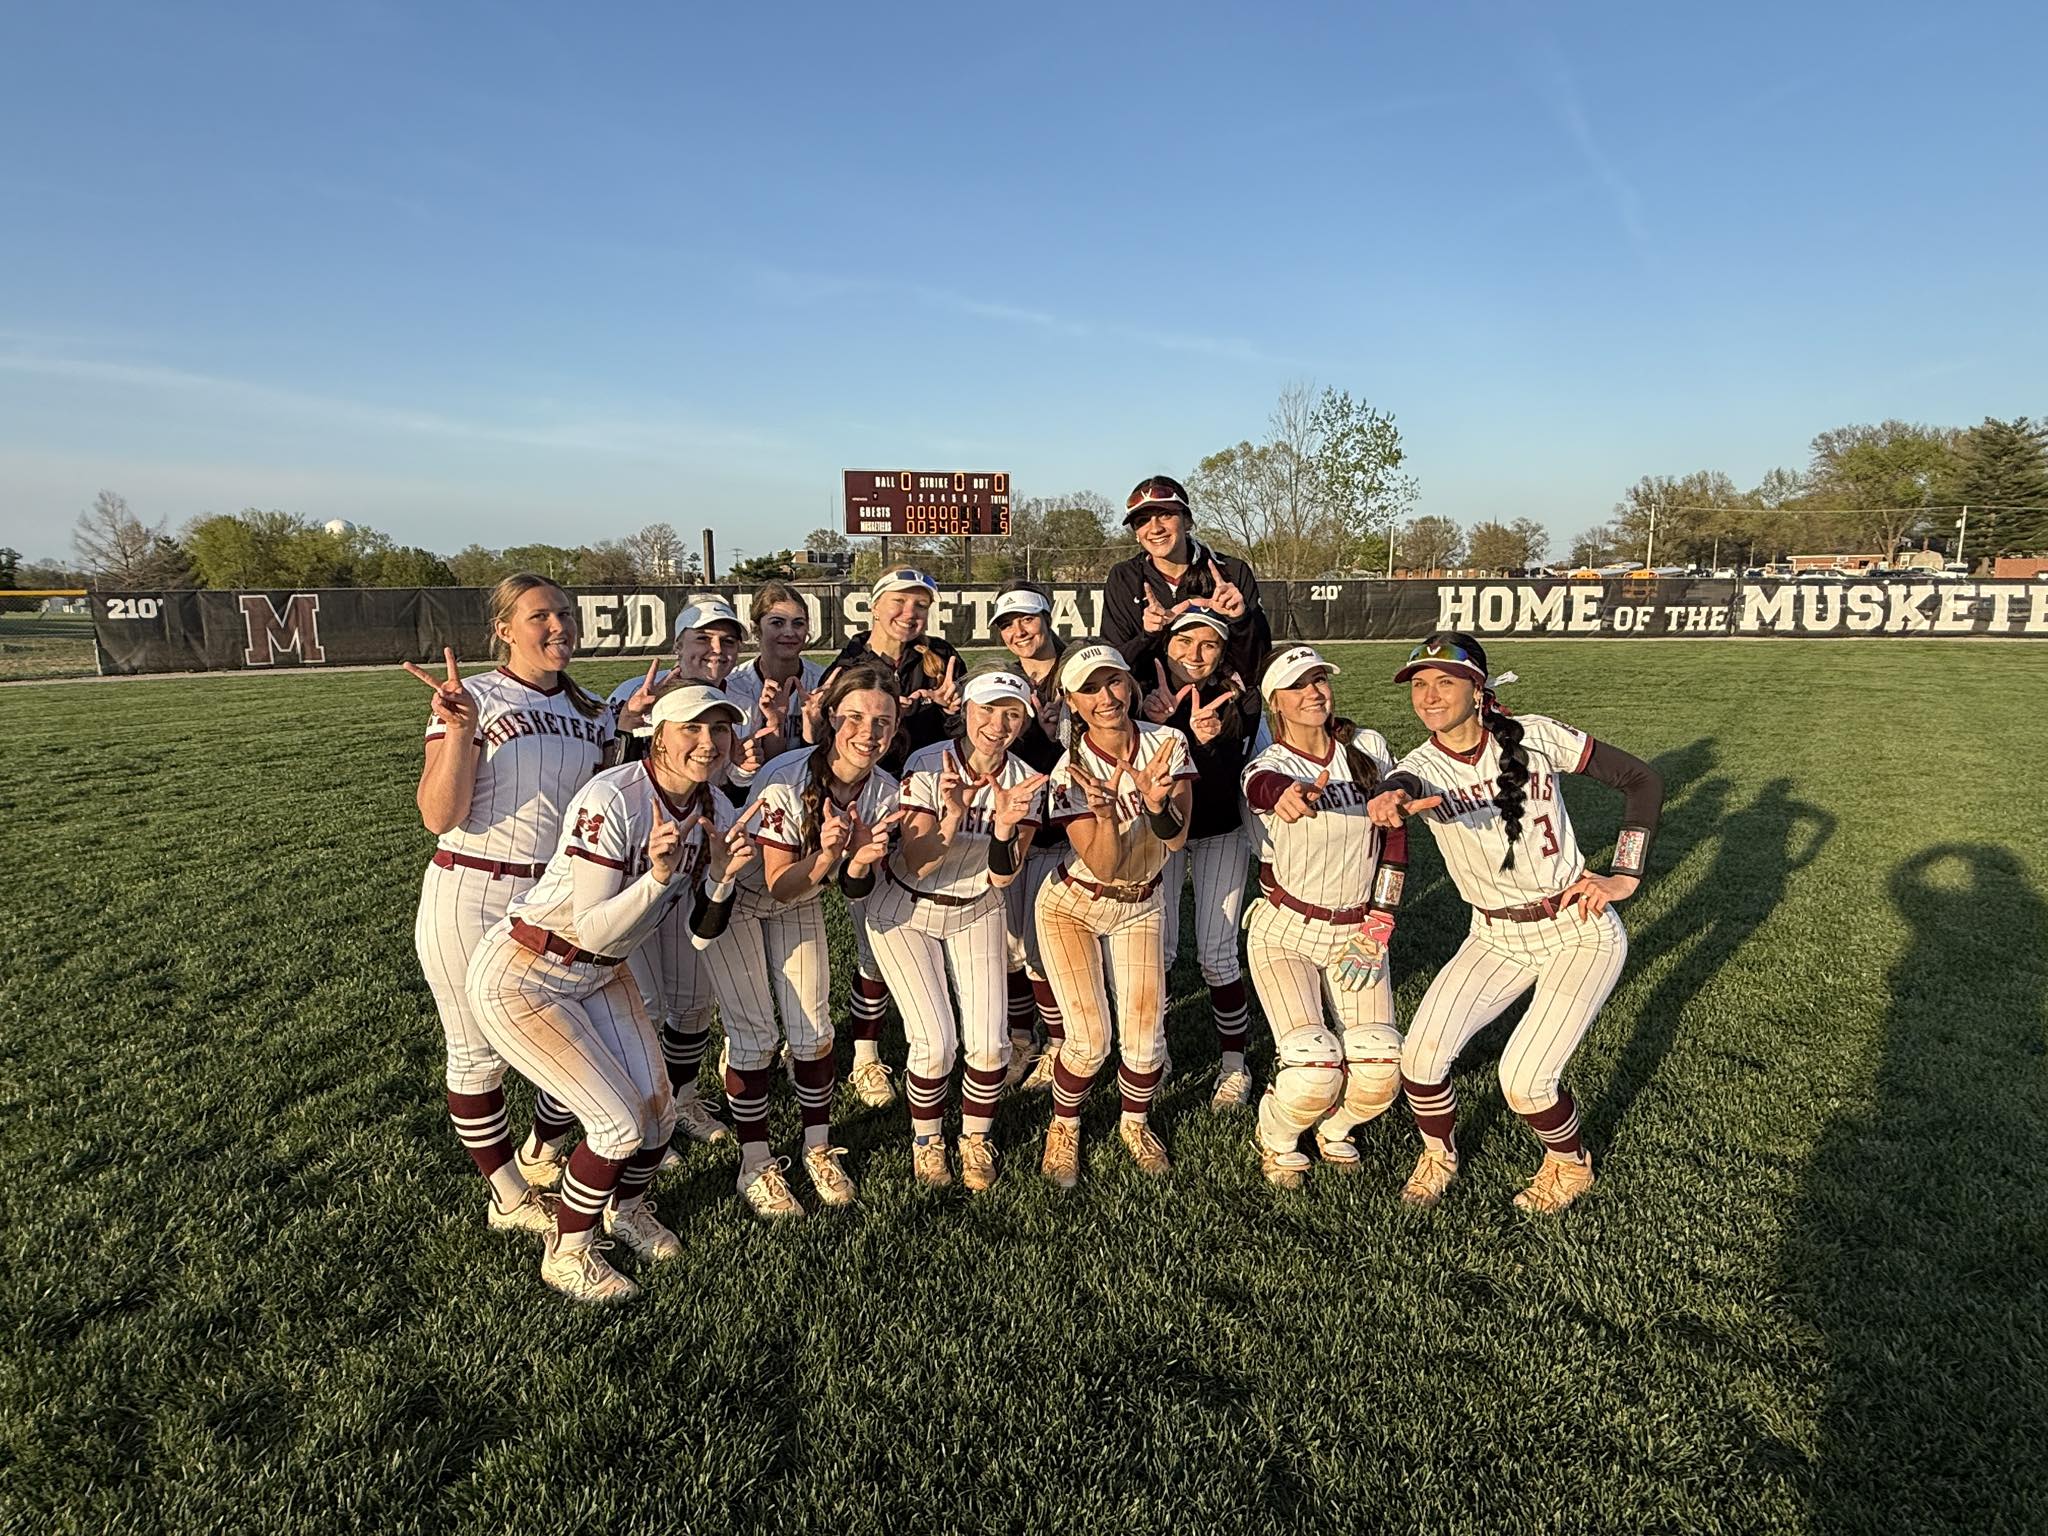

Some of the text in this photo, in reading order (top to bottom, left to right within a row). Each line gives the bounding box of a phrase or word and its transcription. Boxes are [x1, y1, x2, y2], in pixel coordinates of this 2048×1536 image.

[875, 472, 1005, 492] BALL 0 STRIKE 0 OUT 0
[919, 494, 924, 503] 2
[940, 494, 946, 503] 4
[973, 494, 978, 503] 7
[859, 506, 891, 518] GUESTS
[906, 506, 915, 519] 0
[917, 506, 926, 519] 0
[928, 506, 937, 519] 0
[939, 506, 948, 519] 0
[950, 506, 959, 519] 0
[999, 507, 1008, 520] 2
[906, 520, 915, 534] 0
[917, 520, 926, 534] 0
[928, 521, 937, 534] 3
[939, 521, 948, 534] 4
[950, 521, 959, 534] 0
[961, 521, 970, 534] 2
[1000, 521, 1009, 534] 9
[1310, 585, 1343, 601] 210'
[106, 598, 164, 620] 210'
[1435, 585, 1604, 632] HOME
[1613, 606, 1655, 631] OF
[1664, 606, 1729, 631] THE
[238, 593, 326, 666] M
[1080, 647, 1102, 661] WIU
[1533, 814, 1559, 858] 3
